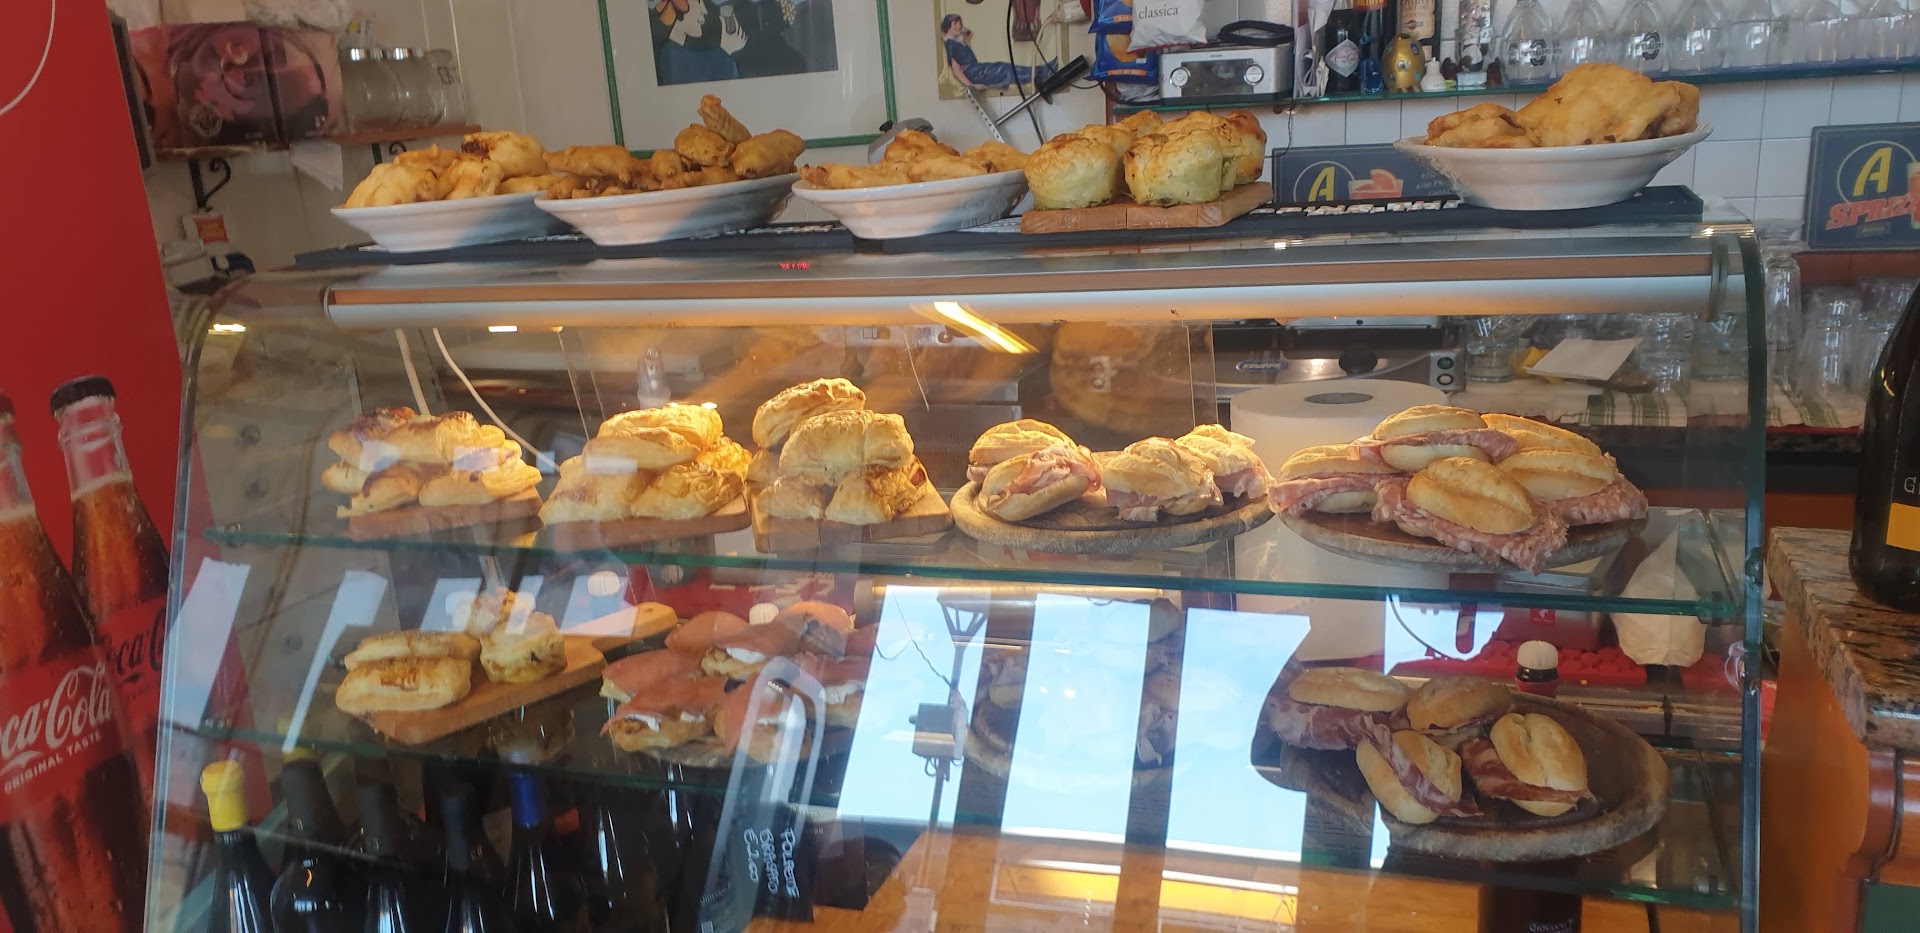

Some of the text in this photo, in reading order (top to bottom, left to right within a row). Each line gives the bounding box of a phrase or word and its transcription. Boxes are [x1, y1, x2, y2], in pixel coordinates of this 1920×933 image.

[1138, 4, 1179, 20] classica
[1307, 166, 1336, 202] A
[1852, 146, 1893, 197] A
[0, 661, 112, 766] ca-Cola
[4, 729, 102, 795] ORIGINAL TASTE
